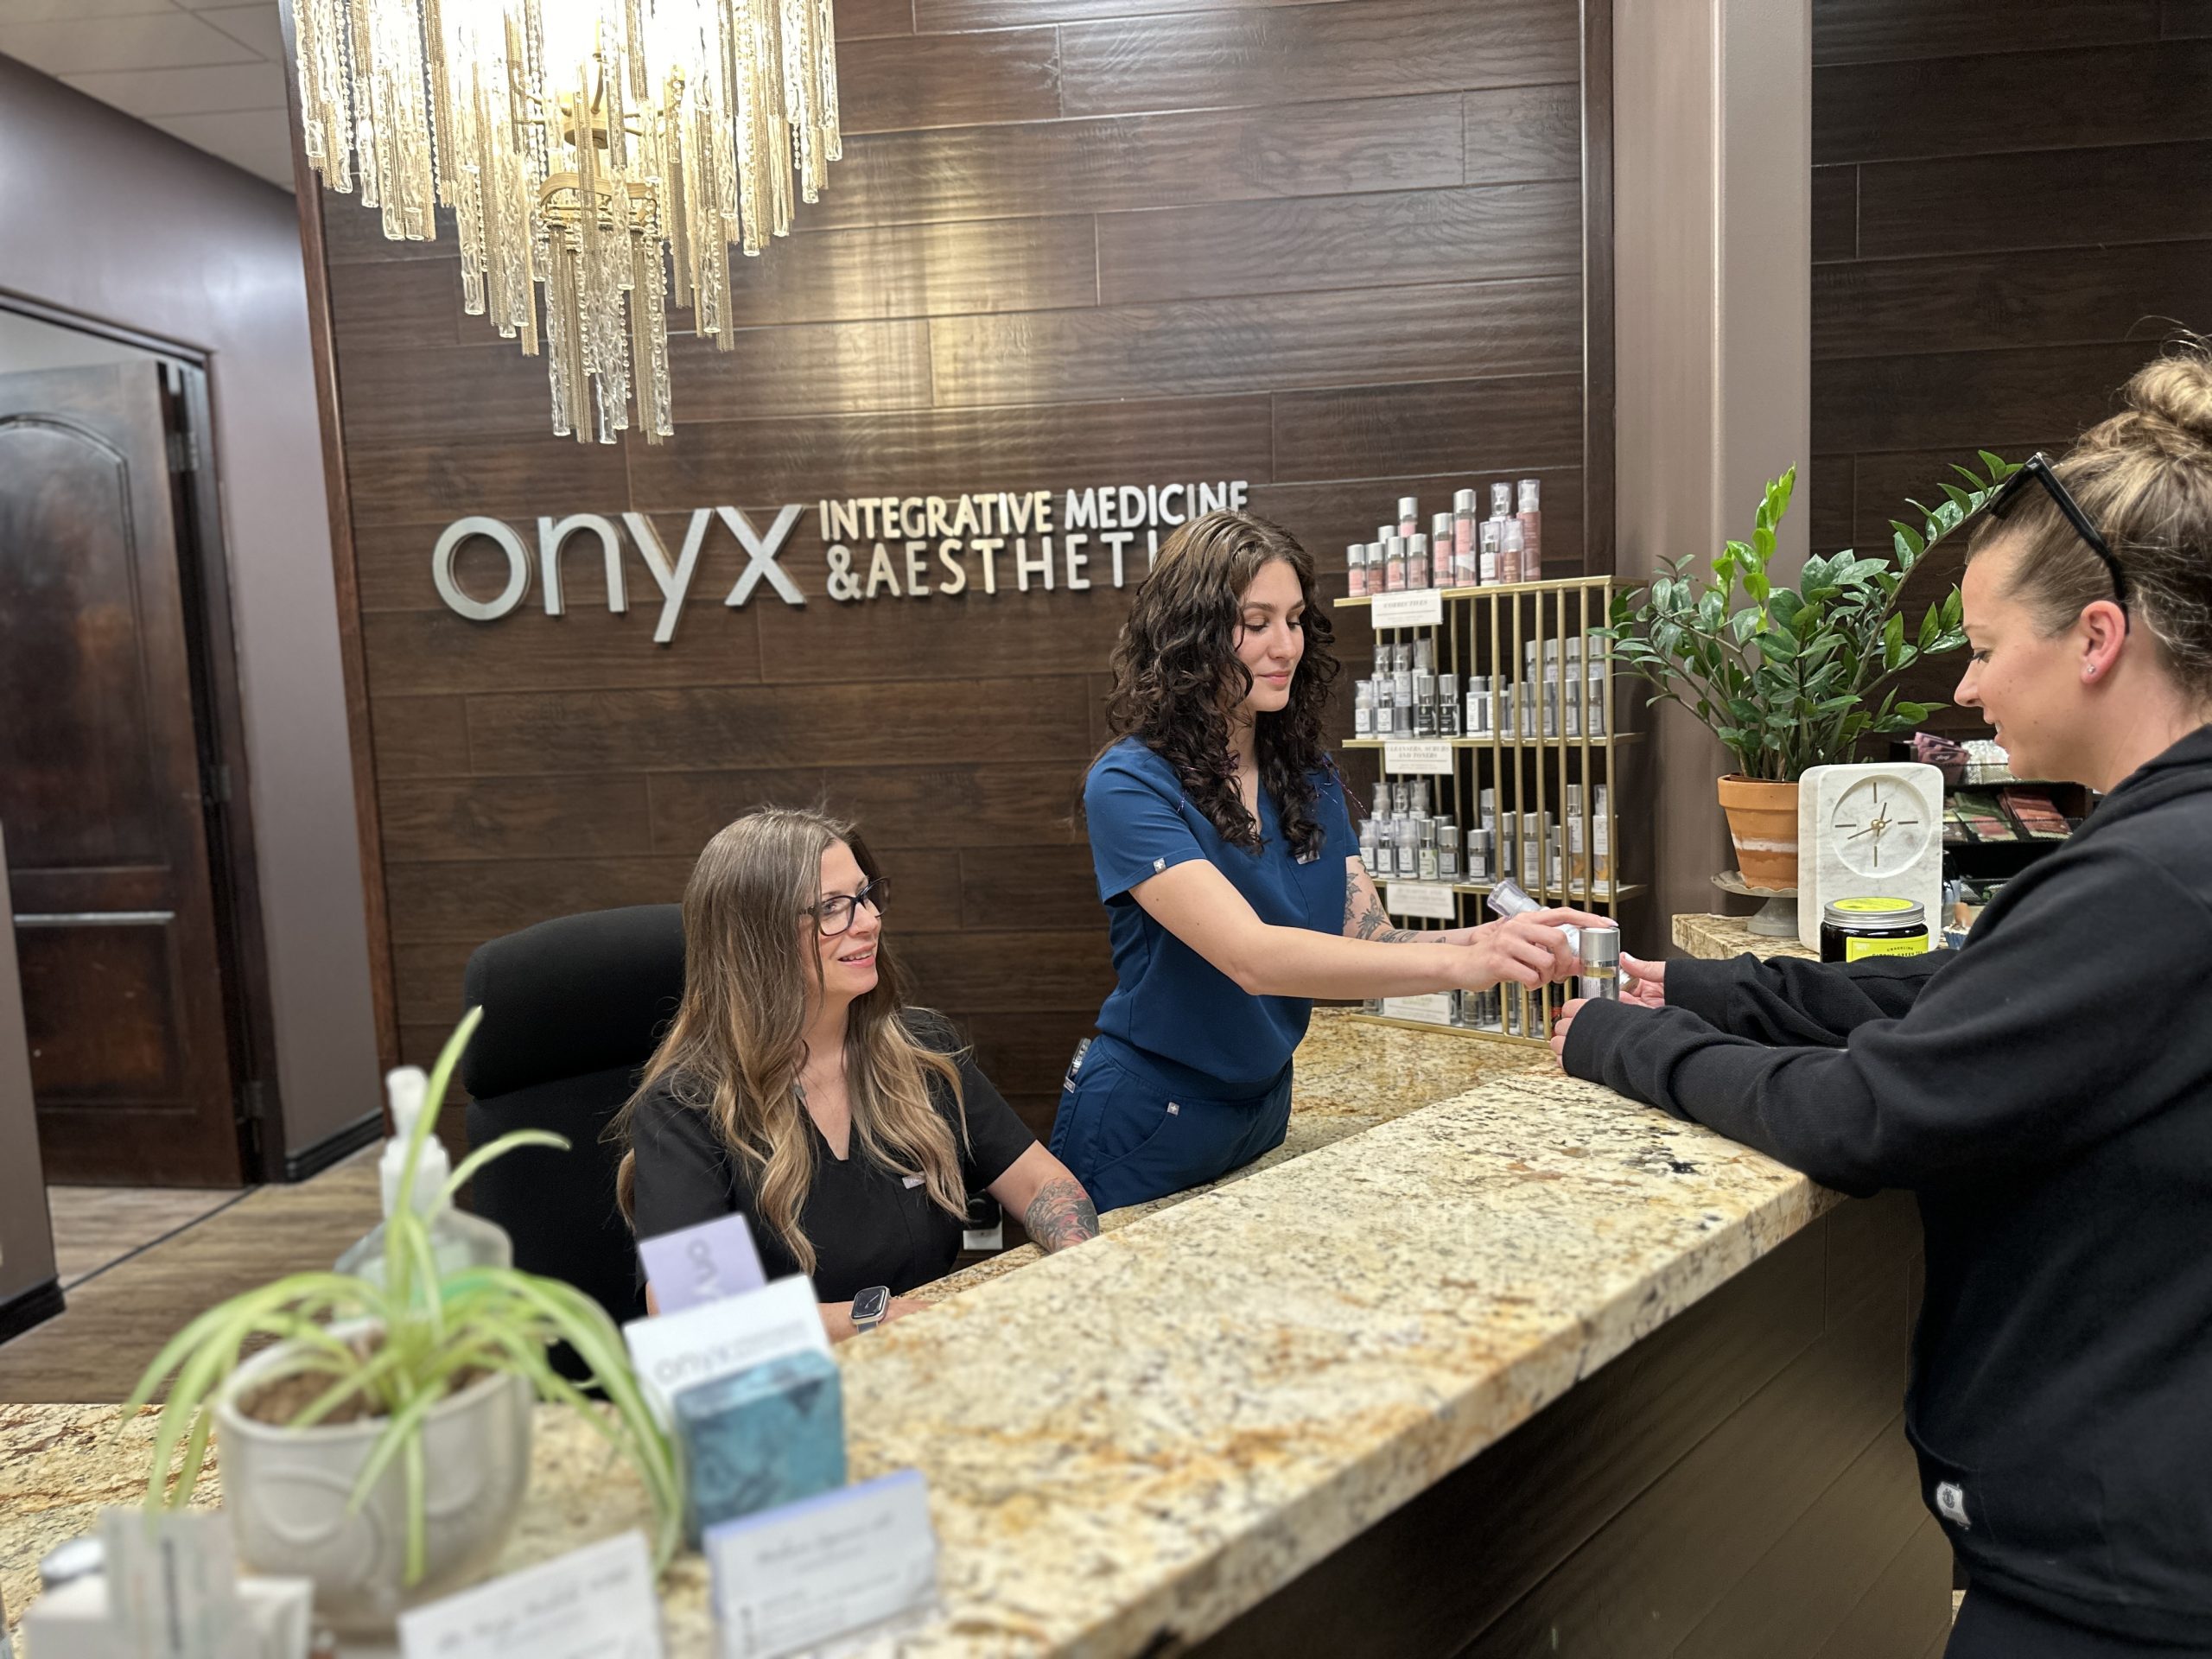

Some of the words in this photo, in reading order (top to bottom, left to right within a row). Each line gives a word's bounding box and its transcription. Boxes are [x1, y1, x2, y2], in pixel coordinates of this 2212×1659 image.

[819, 490, 1053, 541] INTEGRATIVE
[1065, 480, 1249, 530] MEDICINE
[432, 503, 808, 644] onyx
[826, 531, 1159, 602] &AESTHETI
